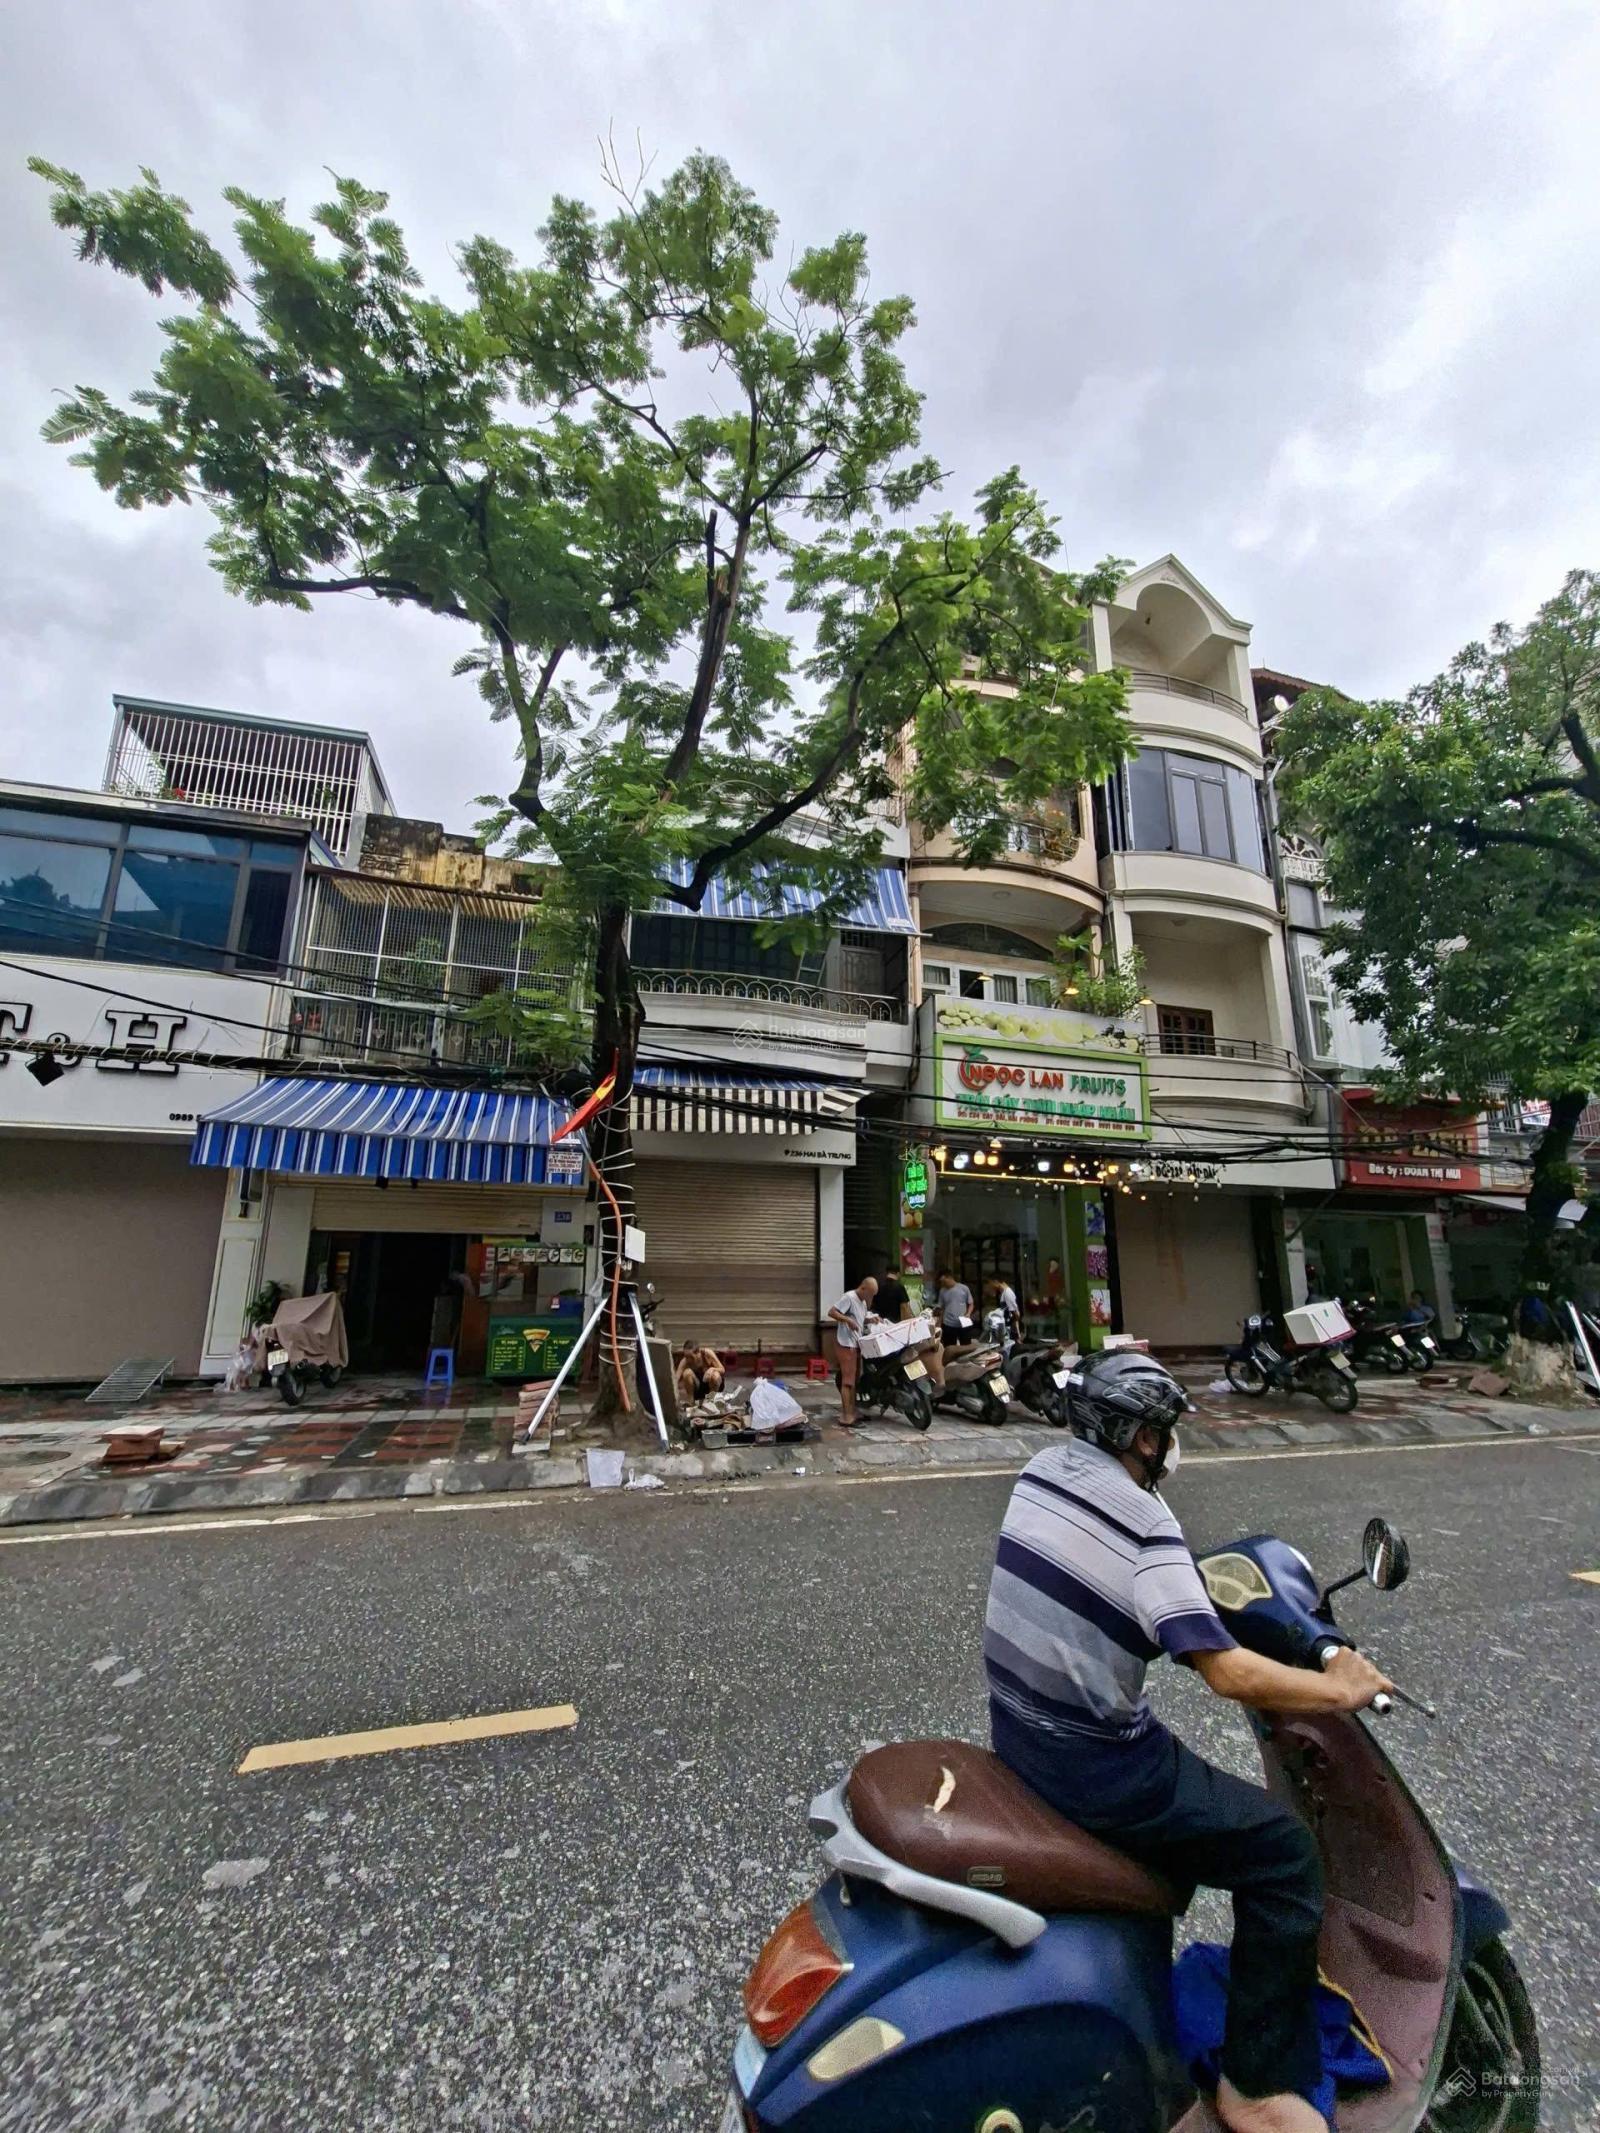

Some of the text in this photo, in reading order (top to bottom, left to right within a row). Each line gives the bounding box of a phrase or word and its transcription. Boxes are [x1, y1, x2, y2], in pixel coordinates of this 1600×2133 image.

[969, 1063, 1127, 1098] NGỌC LAN FRUITS
[169, 1113, 193, 1122] 0989
